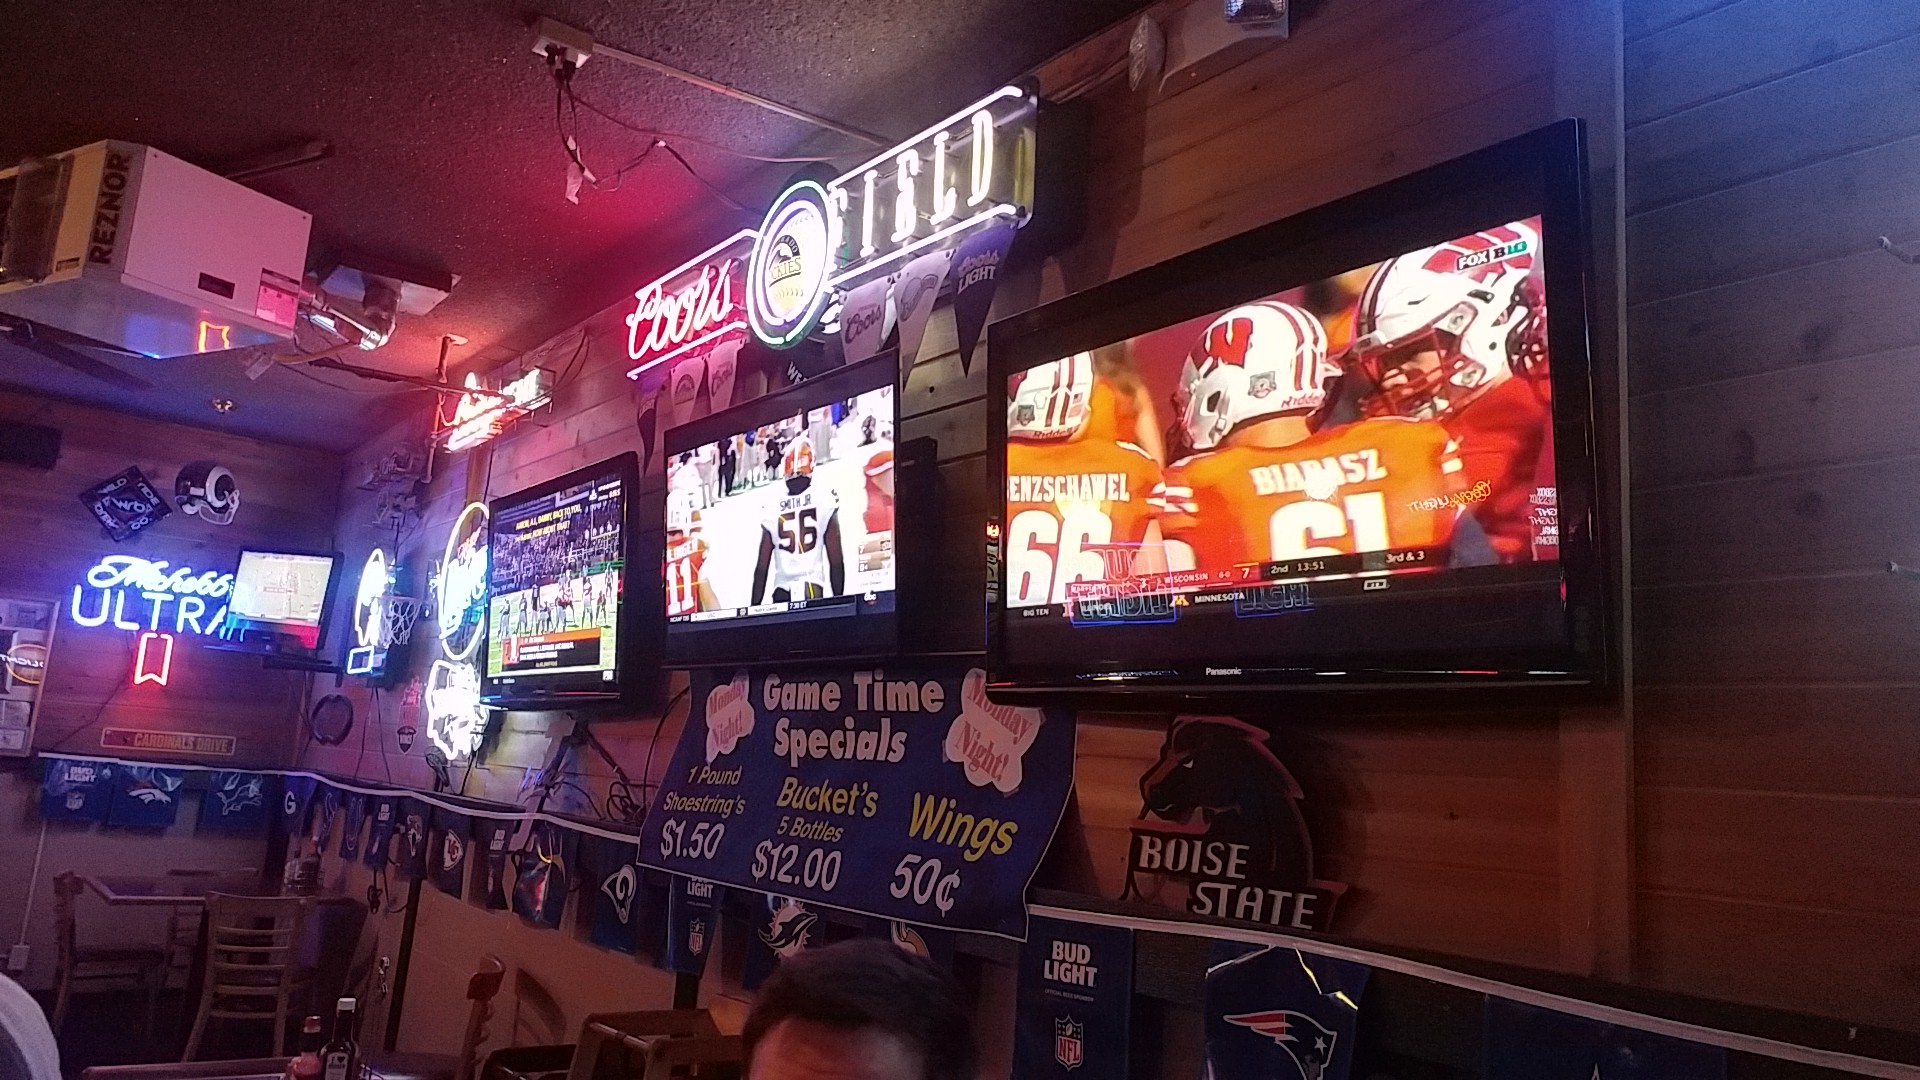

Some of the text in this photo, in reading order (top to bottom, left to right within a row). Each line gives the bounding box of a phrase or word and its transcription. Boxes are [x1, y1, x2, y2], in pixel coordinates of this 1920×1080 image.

[89, 153, 131, 264] REZNOR
[957, 265, 996, 295] LIGHT
[1458, 250, 1488, 270] FOX
[625, 259, 734, 360] Coors
[844, 304, 882, 344] Coors
[778, 507, 817, 554] 56
[1007, 510, 1113, 608] 66
[1165, 572, 1208, 584] WISCONSIN
[1241, 567, 1250, 578] 7
[1271, 551, 1425, 574] 2nd 13:51 3rd & 3
[667, 557, 695, 615] 11
[1194, 593, 1246, 604] MINNESOTA
[763, 669, 945, 713] Game Time
[1206, 667, 1242, 676] Panasonic
[966, 671, 1033, 745] Monday
[134, 733, 228, 752] CARDINALS DRIVE
[712, 709, 743, 751] Night!
[774, 717, 908, 768] Specials
[954, 719, 1010, 782] Night!
[64, 772, 97, 782] LIGHT
[688, 766, 742, 787] 1 Pound
[776, 776, 879, 819] Bucket's
[663, 791, 746, 817] Shoestring's
[660, 817, 726, 861] $1.50
[777, 818, 844, 844] 5 Bottles
[908, 791, 1019, 862] Wings
[751, 839, 843, 892] $12.00
[1137, 835, 1251, 880] BOISE
[686, 881, 714, 899] LIGHT
[890, 853, 961, 918] 50¢
[1191, 881, 1318, 930] STATE
[1043, 959, 1098, 988] LIGHT
[1051, 940, 1091, 965] BUD
[1058, 1038, 1081, 1062] NFL
